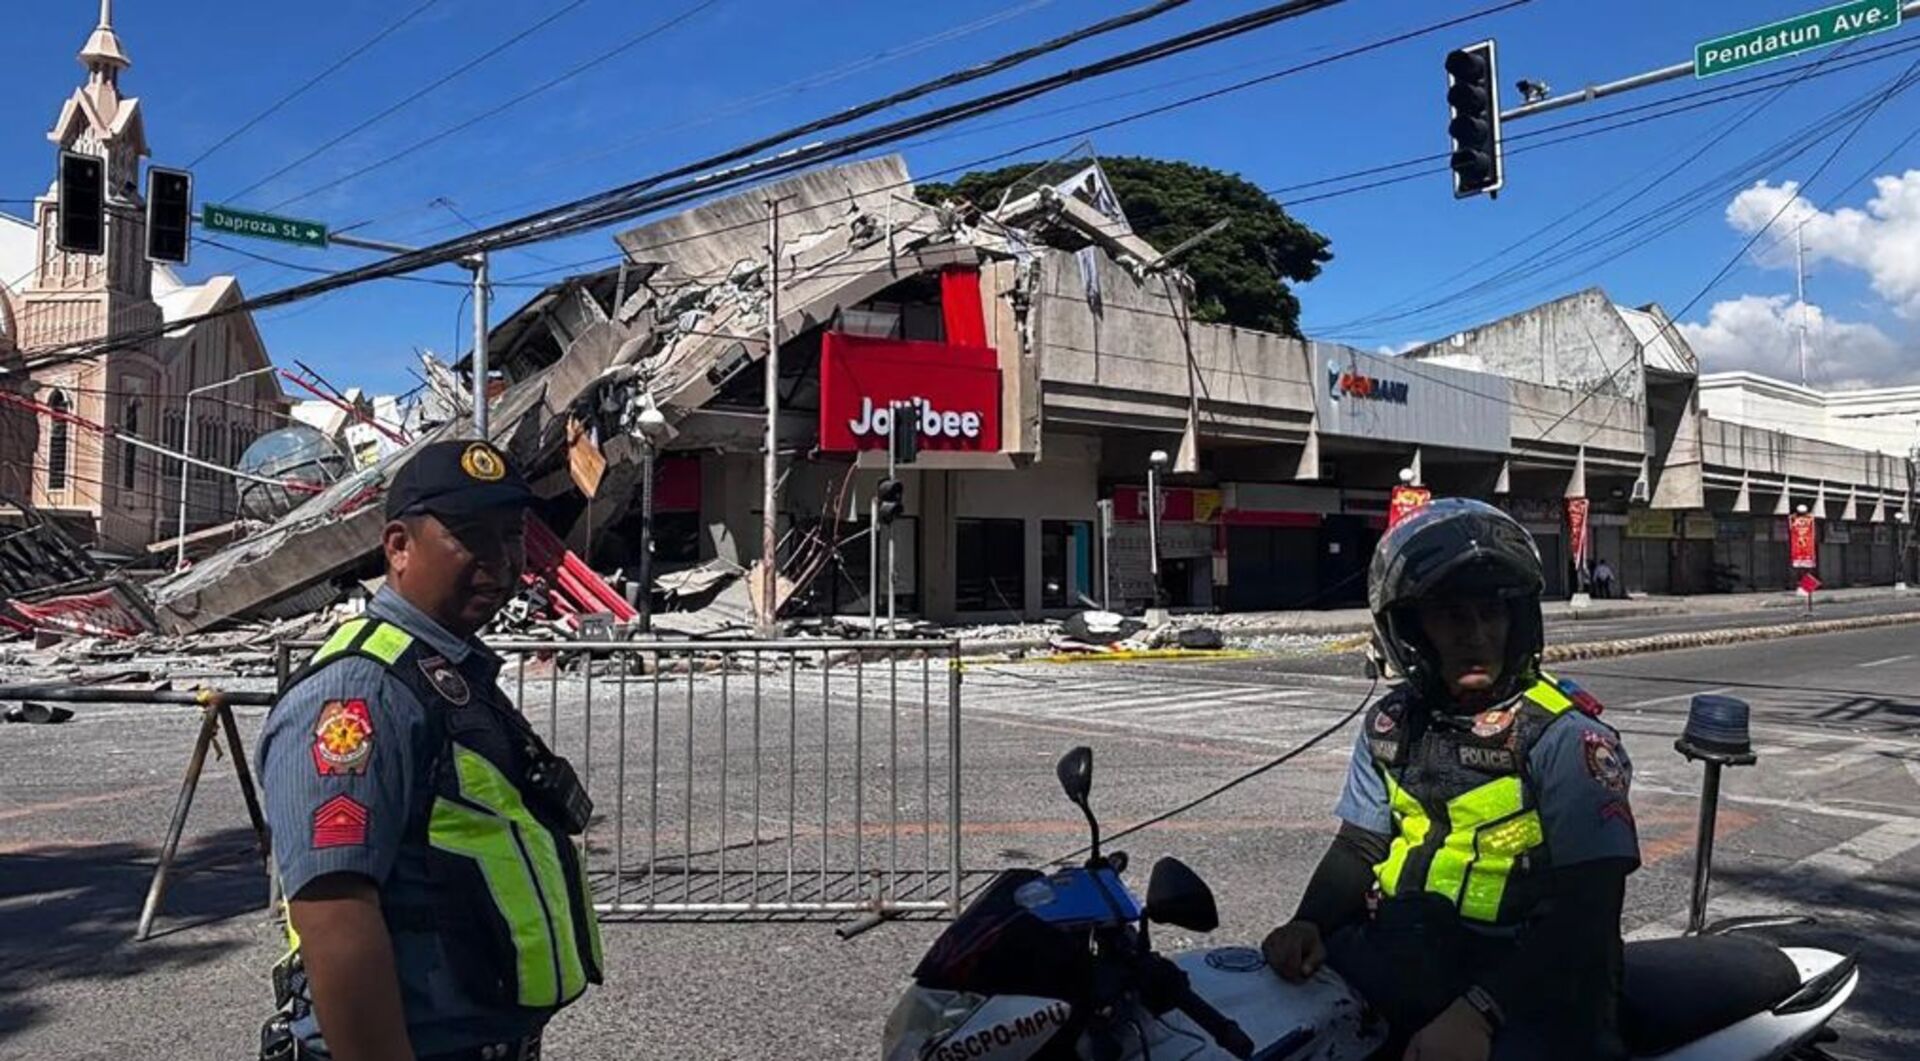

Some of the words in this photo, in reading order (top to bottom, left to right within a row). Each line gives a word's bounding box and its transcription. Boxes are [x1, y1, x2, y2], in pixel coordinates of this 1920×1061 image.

[1705, 24, 1820, 67] Pendatun
[1833, 7, 1889, 33] Ave.
[213, 212, 276, 234] Daproza
[849, 396, 981, 438] Jobee
[1459, 744, 1513, 770] POLICE
